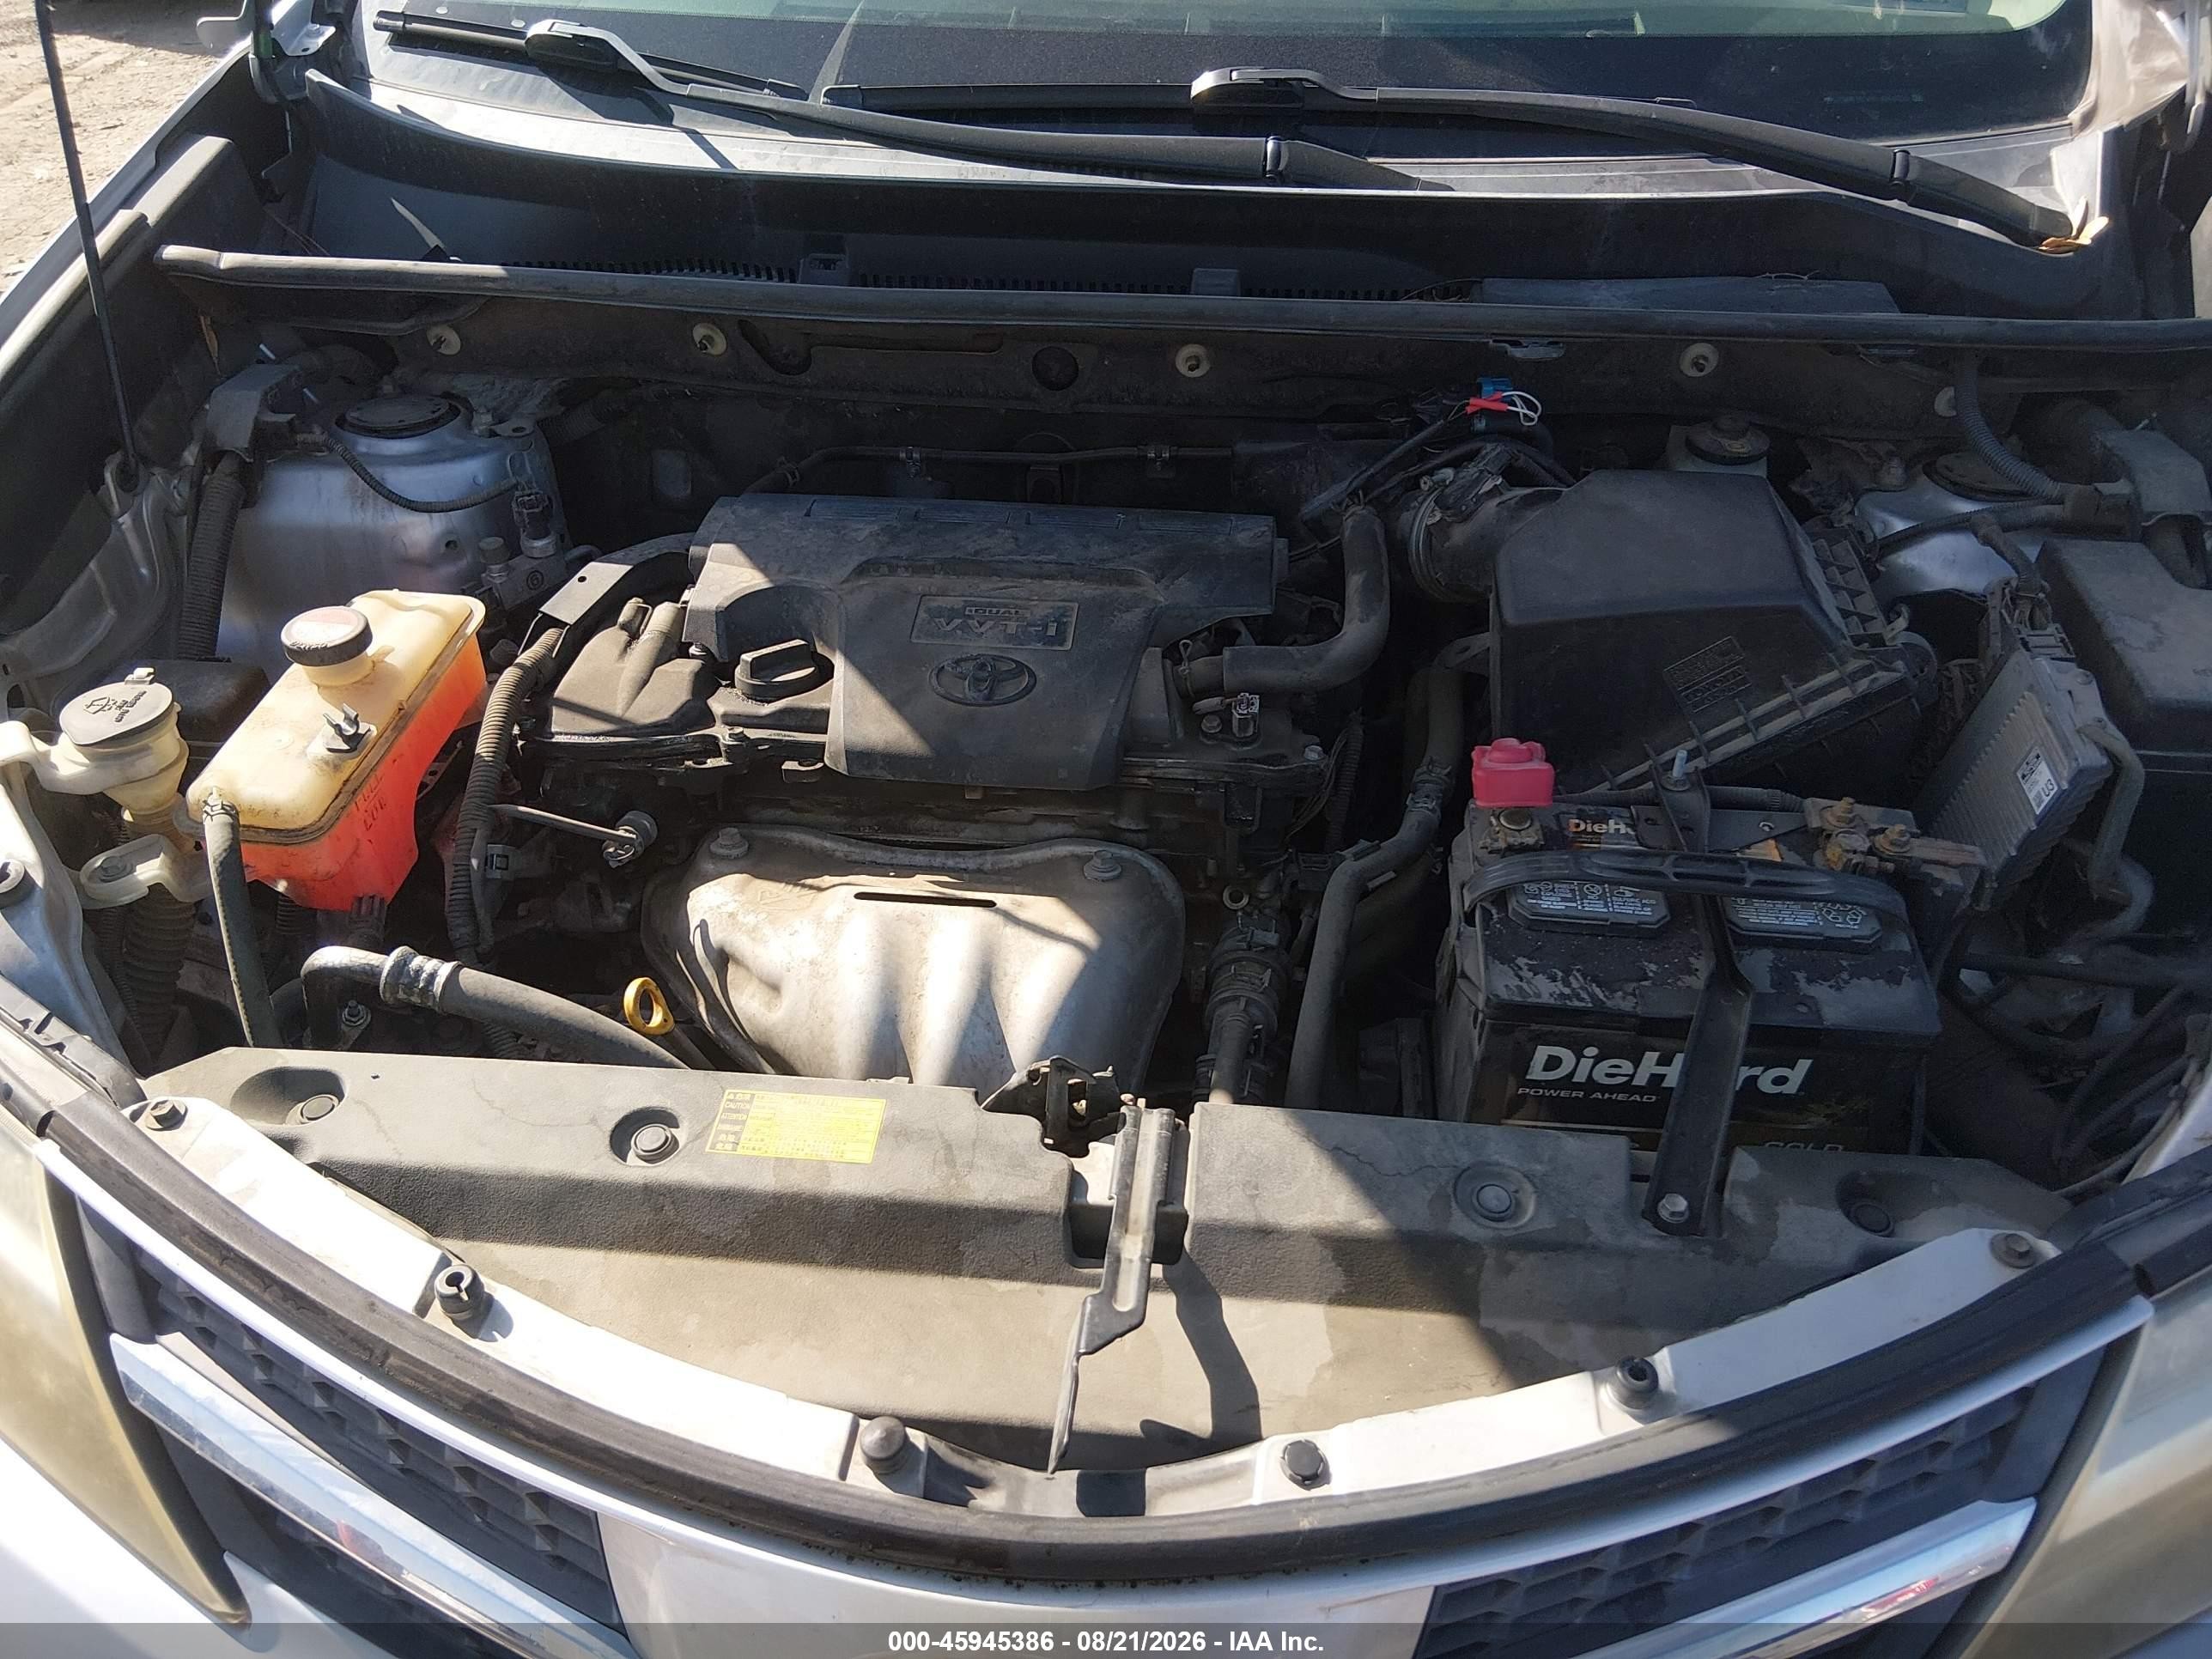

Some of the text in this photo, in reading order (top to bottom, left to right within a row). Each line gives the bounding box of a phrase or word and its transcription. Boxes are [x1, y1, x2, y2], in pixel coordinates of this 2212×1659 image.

[1525, 1044, 1814, 1095] DieHrd
[1517, 1087, 1657, 1103] POWER AHEAD
